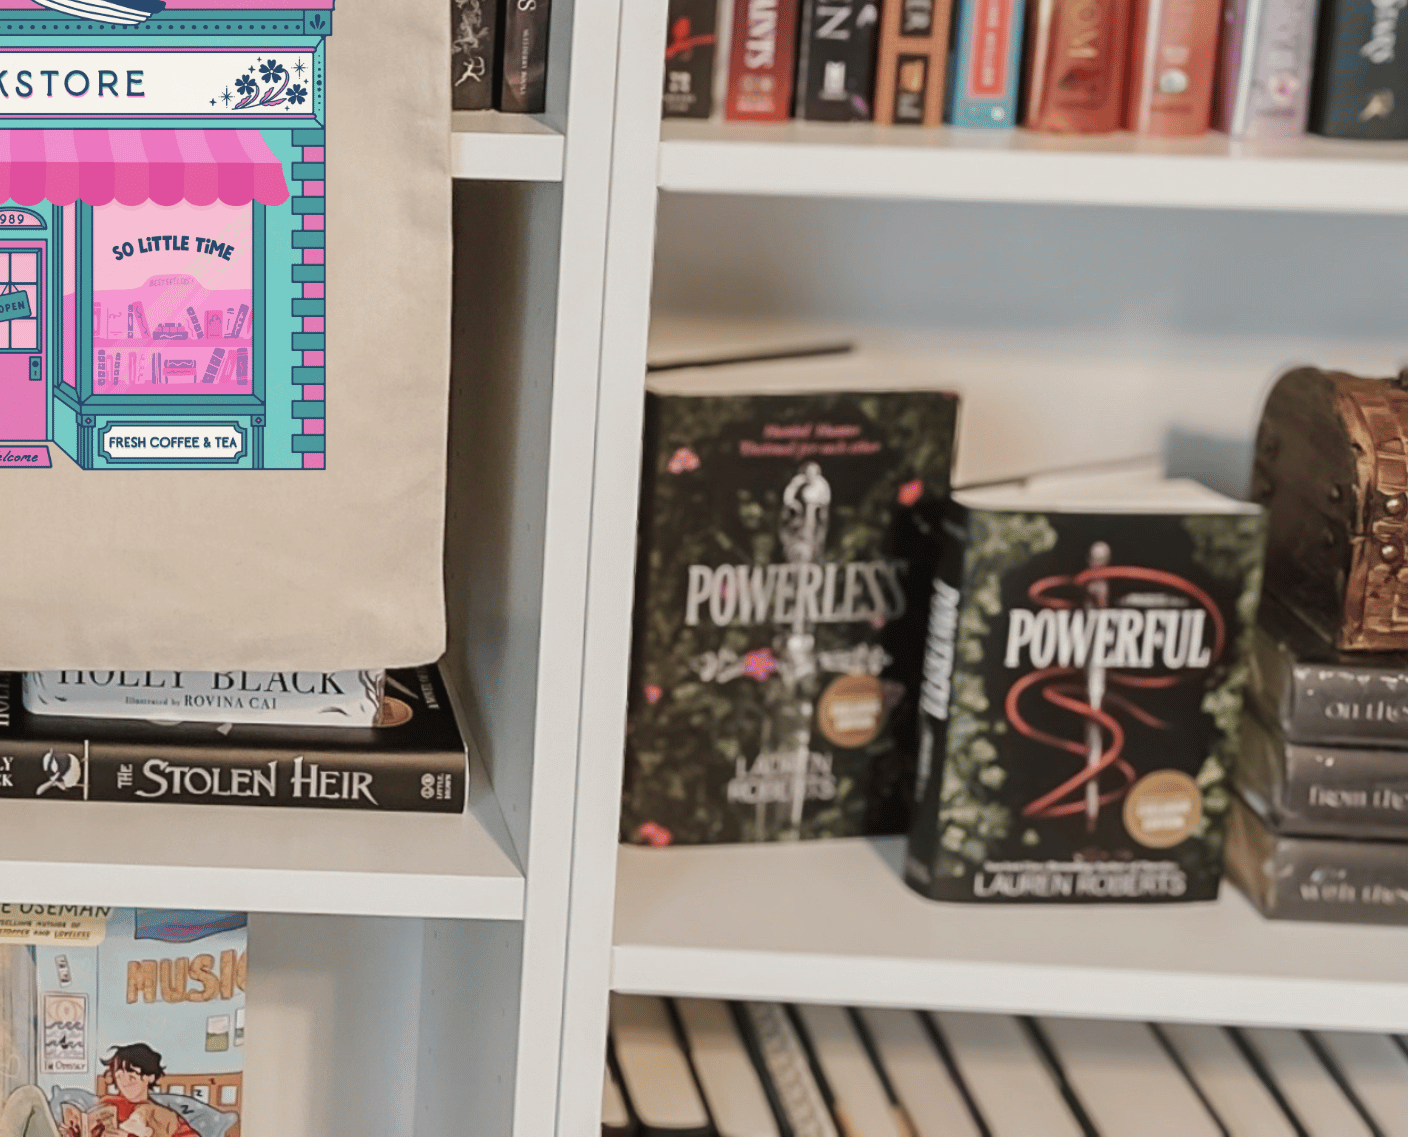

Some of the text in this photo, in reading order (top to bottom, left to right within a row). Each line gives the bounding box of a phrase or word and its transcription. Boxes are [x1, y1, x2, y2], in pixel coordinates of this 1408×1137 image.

[112, 240, 134, 261] SO
[108, 436, 238, 449] FRESH COFFEE & TEA
[685, 563, 908, 626] POWERLESS
[1004, 608, 1211, 669] POWERFUL
[184, 694, 245, 709] ROVINA
[248, 696, 278, 711] CAI
[117, 755, 380, 807] THE STOLEN HEIR
